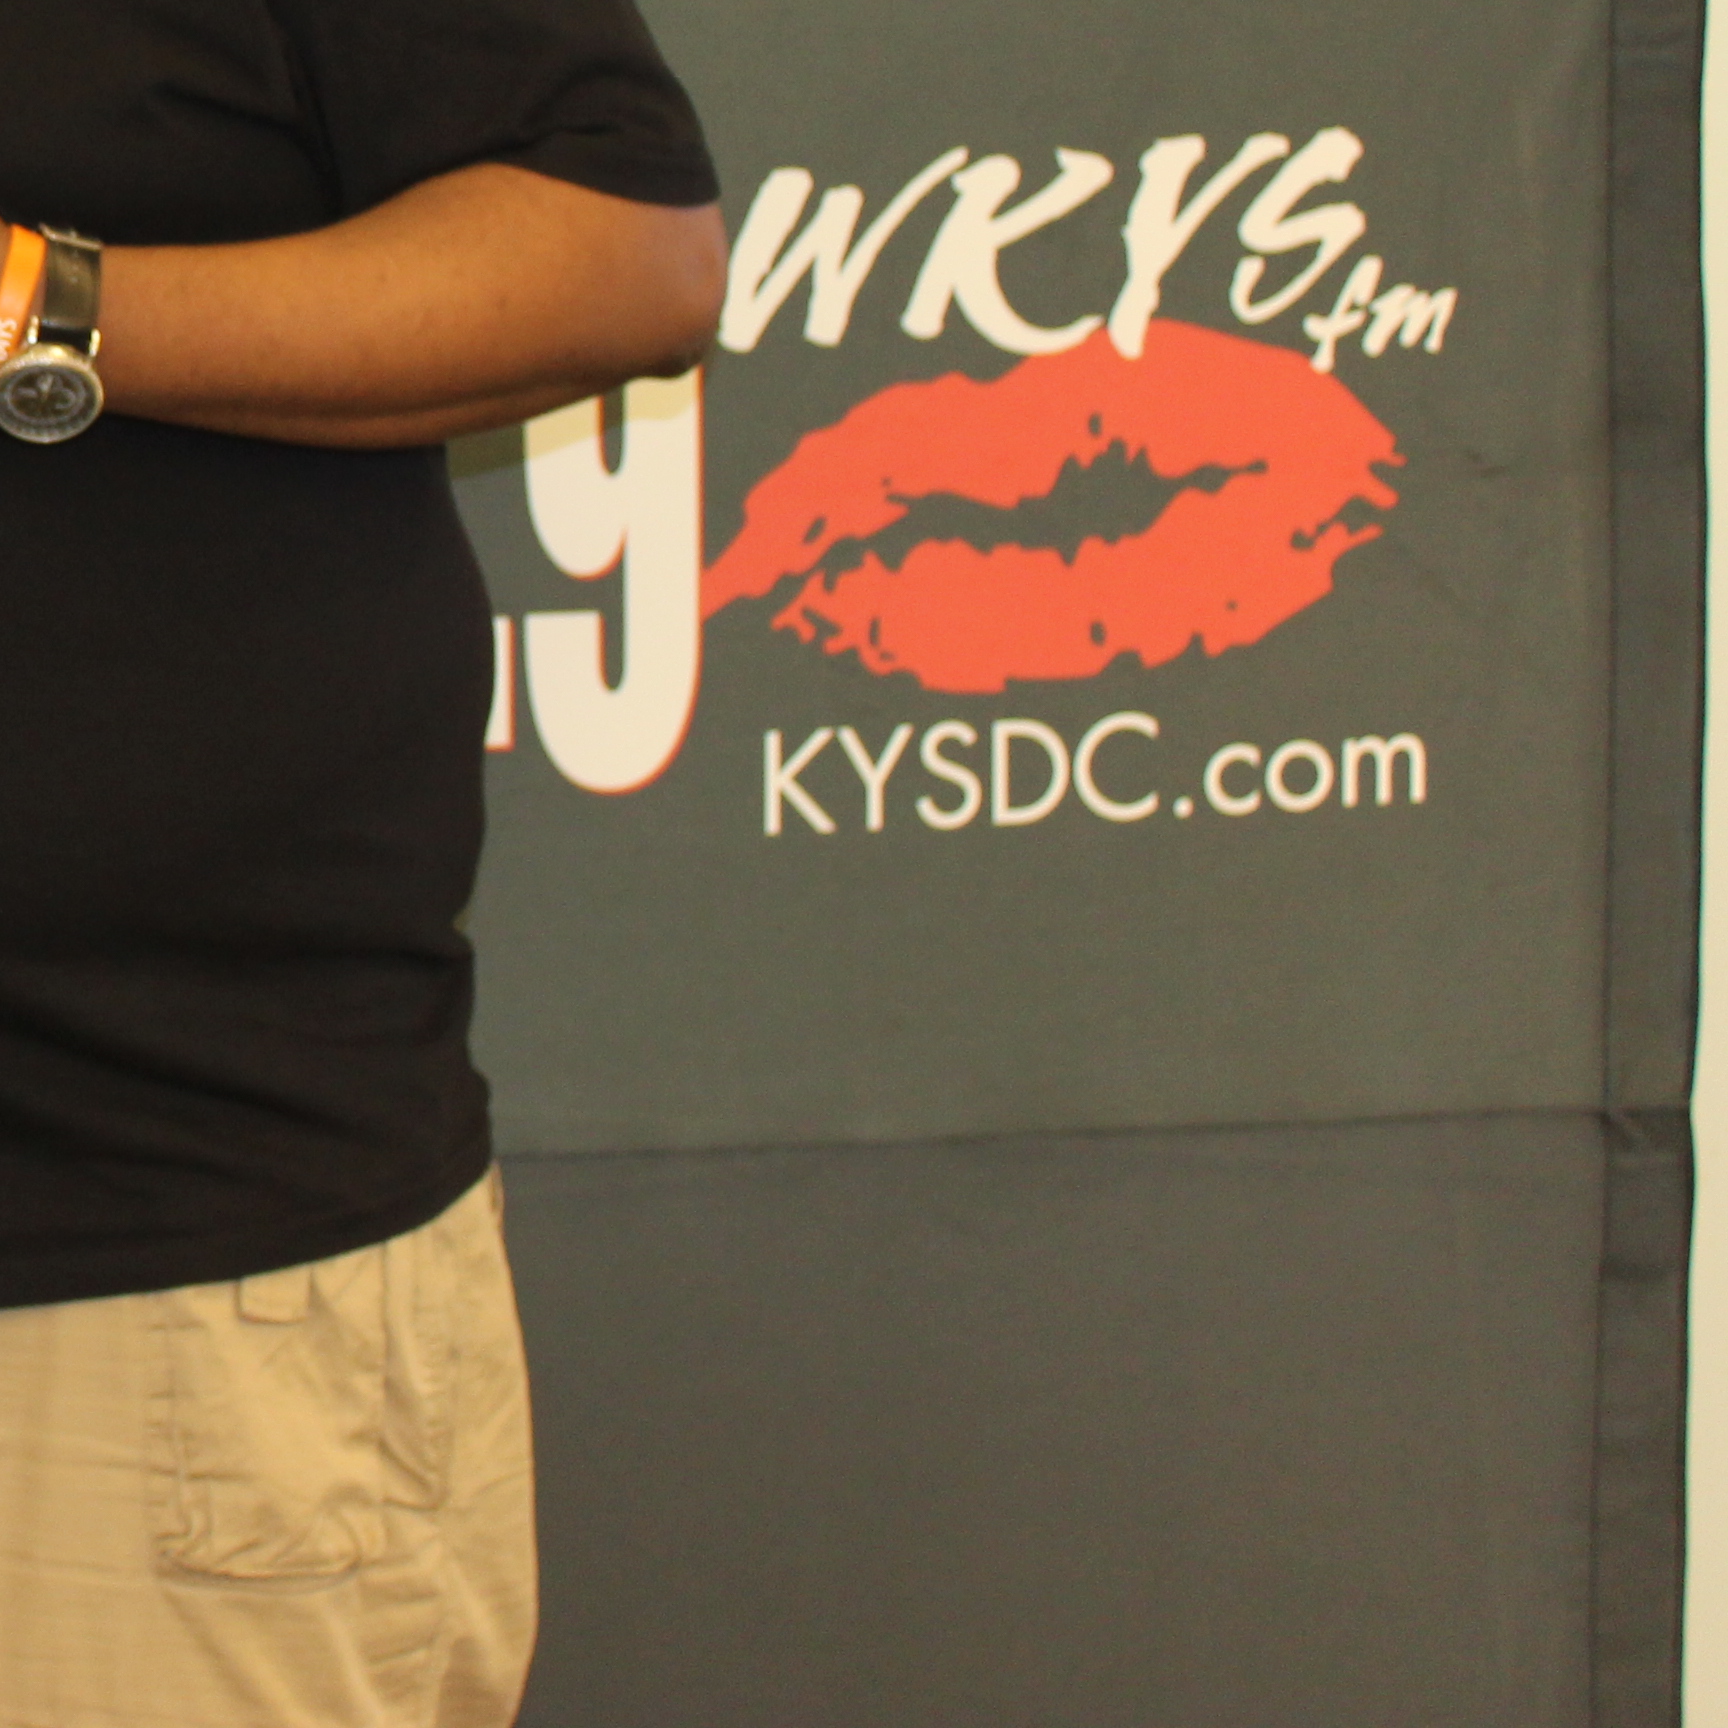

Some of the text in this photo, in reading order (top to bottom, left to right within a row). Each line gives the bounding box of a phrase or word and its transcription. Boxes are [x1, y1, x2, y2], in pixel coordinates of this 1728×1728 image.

[719, 129, 1455, 371] WKYS fm
[765, 713, 1424, 834] KYSDC.com
